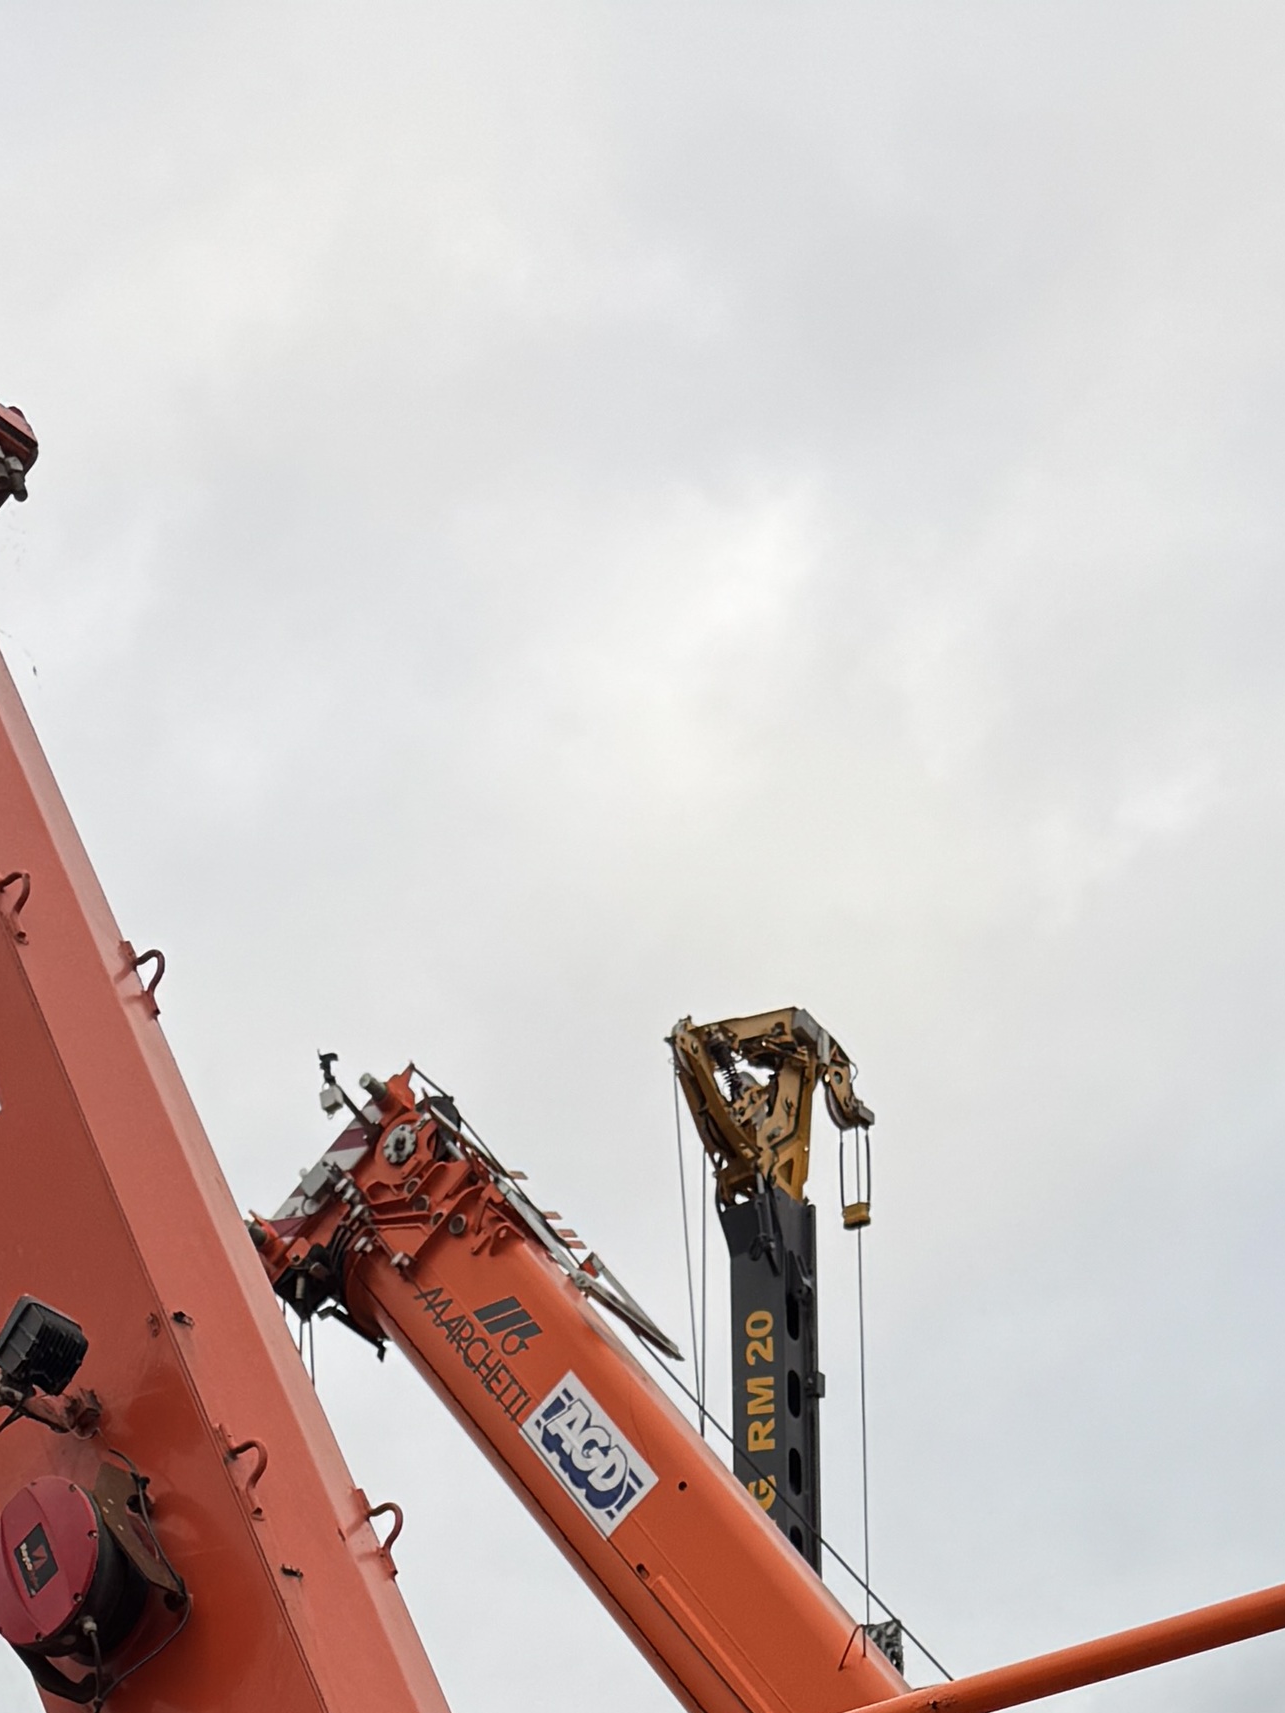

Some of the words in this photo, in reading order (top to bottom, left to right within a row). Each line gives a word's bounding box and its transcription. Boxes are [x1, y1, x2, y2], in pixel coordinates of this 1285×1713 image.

[413, 1287, 533, 1421] MARCHETTI
[745, 1310, 774, 1366] 20
[546, 1398, 628, 1493] AGD
[746, 1376, 776, 1452] RM
